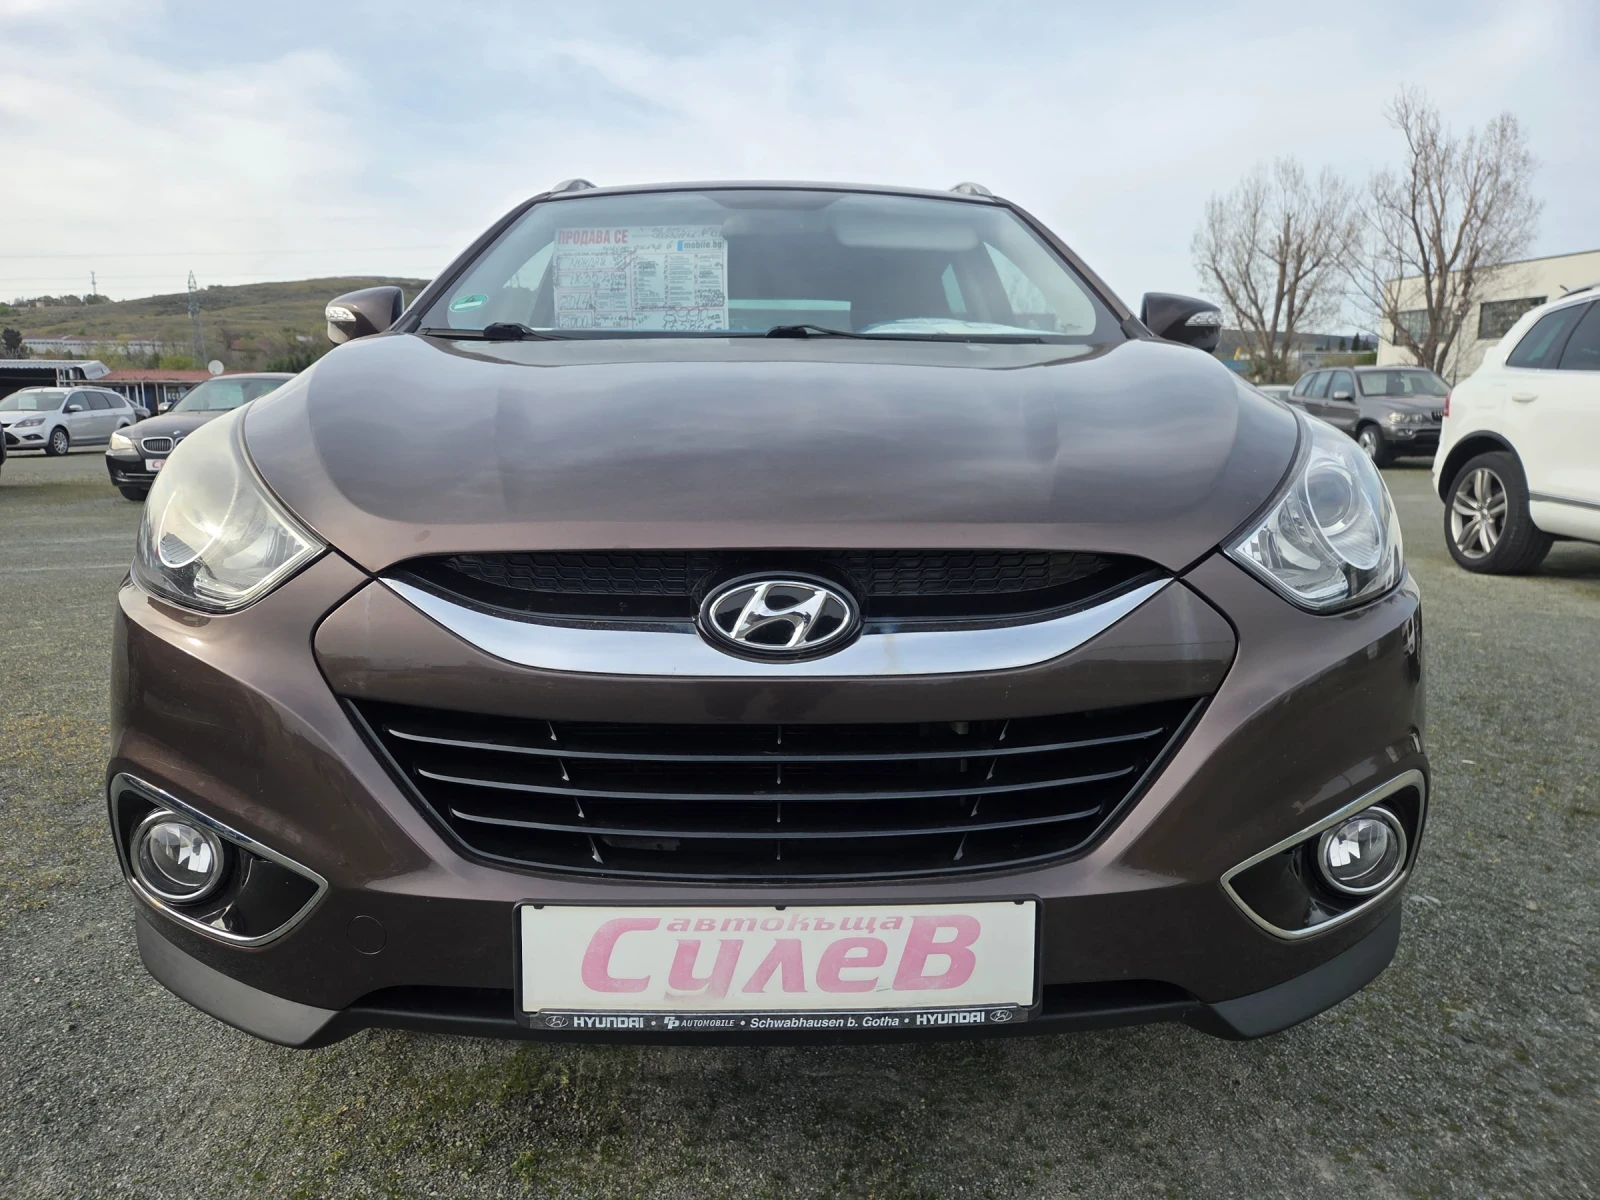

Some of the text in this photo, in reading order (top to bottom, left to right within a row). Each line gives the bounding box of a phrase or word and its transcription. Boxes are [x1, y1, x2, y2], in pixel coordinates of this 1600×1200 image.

[558, 229, 628, 246] ПРОДАВА СЕ
[683, 240, 722, 250] mobile.bg
[666, 914, 904, 933] автокъща
[573, 1016, 644, 1029] HYUNDAI
[680, 1018, 735, 1028] AUTOMOBILE
[749, 1016, 844, 1029] Schwabhausen
[847, 1016, 859, 1028] b.
[862, 1016, 900, 1028] Gotha
[916, 1011, 985, 1025] HYUNDAI
